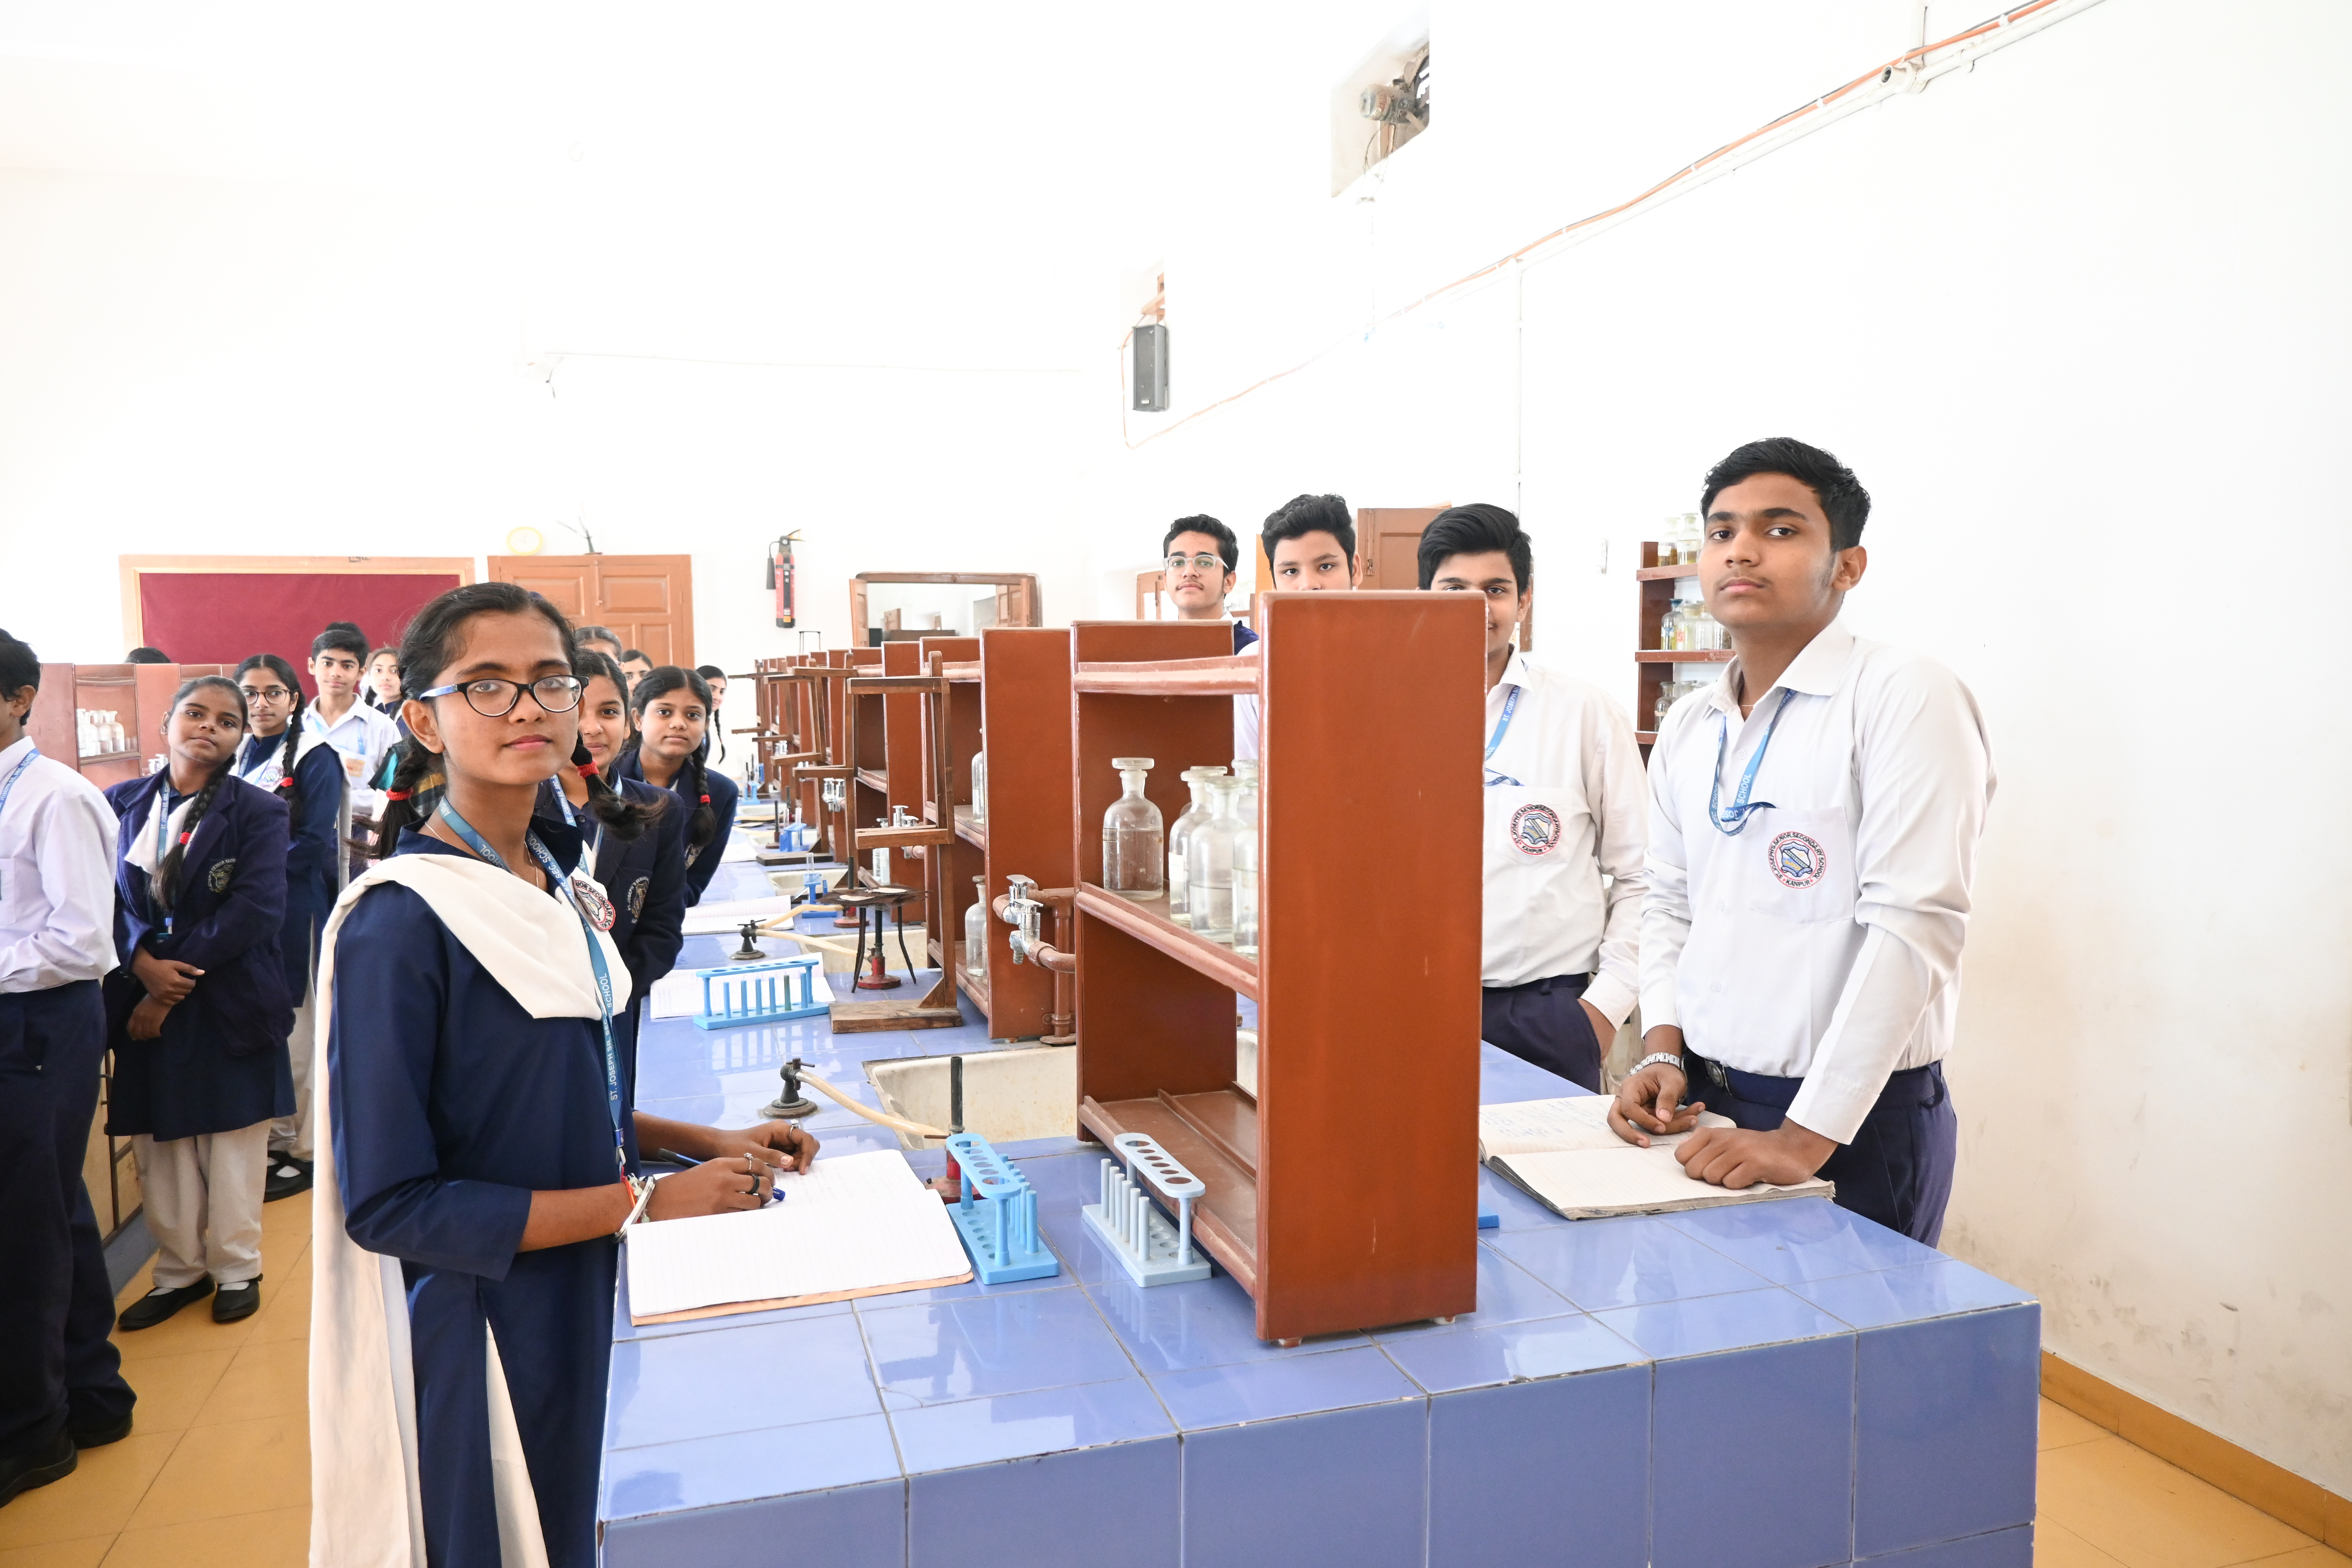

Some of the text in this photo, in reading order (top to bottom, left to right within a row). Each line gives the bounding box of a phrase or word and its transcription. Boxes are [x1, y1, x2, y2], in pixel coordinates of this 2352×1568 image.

[1505, 693, 1517, 714] JOSEPH
[1736, 773, 1752, 804] SCHOOL
[560, 798, 571, 815] JOSEPH
[528, 833, 570, 892] SR. SEC. SCHOOL
[1773, 833, 1791, 845] SENIOR
[1792, 833, 1824, 856] SECONDARY
[1812, 857, 1824, 879] SCHOOL
[1786, 879, 1811, 887] KANPUR
[588, 887, 613, 918] SECONDARY
[599, 972, 612, 1008] SCHOOL
[608, 1053, 617, 1086] JOSEPH
